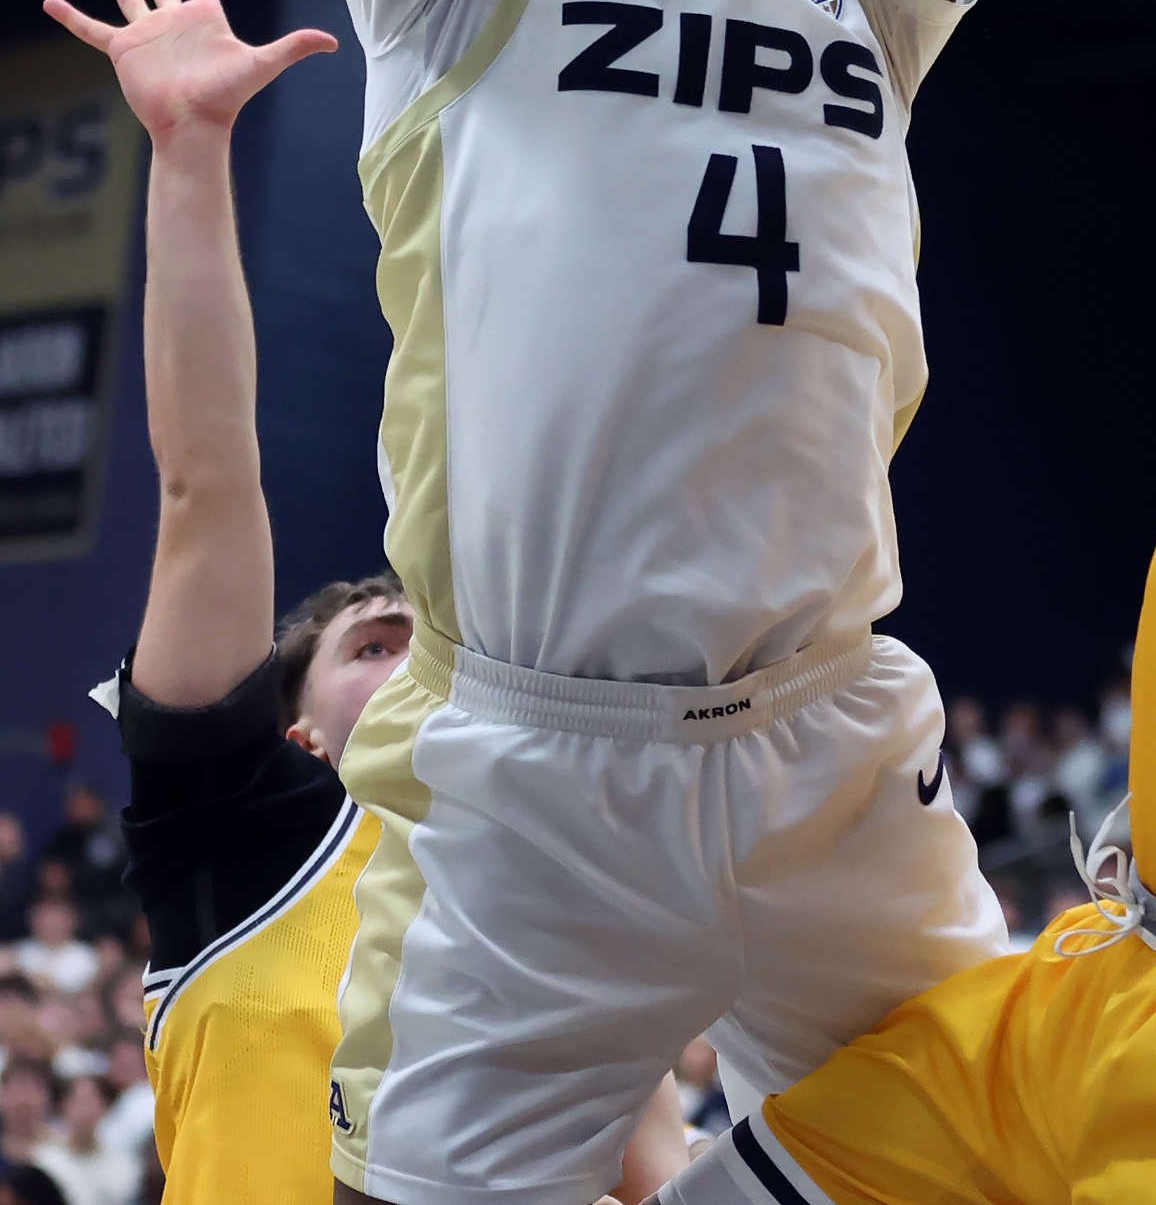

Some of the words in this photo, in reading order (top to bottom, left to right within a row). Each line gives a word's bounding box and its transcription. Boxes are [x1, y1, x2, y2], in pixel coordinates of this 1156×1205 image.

[557, 0, 885, 141] ZIPS
[686, 144, 800, 327] 4
[682, 698, 752, 721] AKRON
[329, 1079, 352, 1131] A
